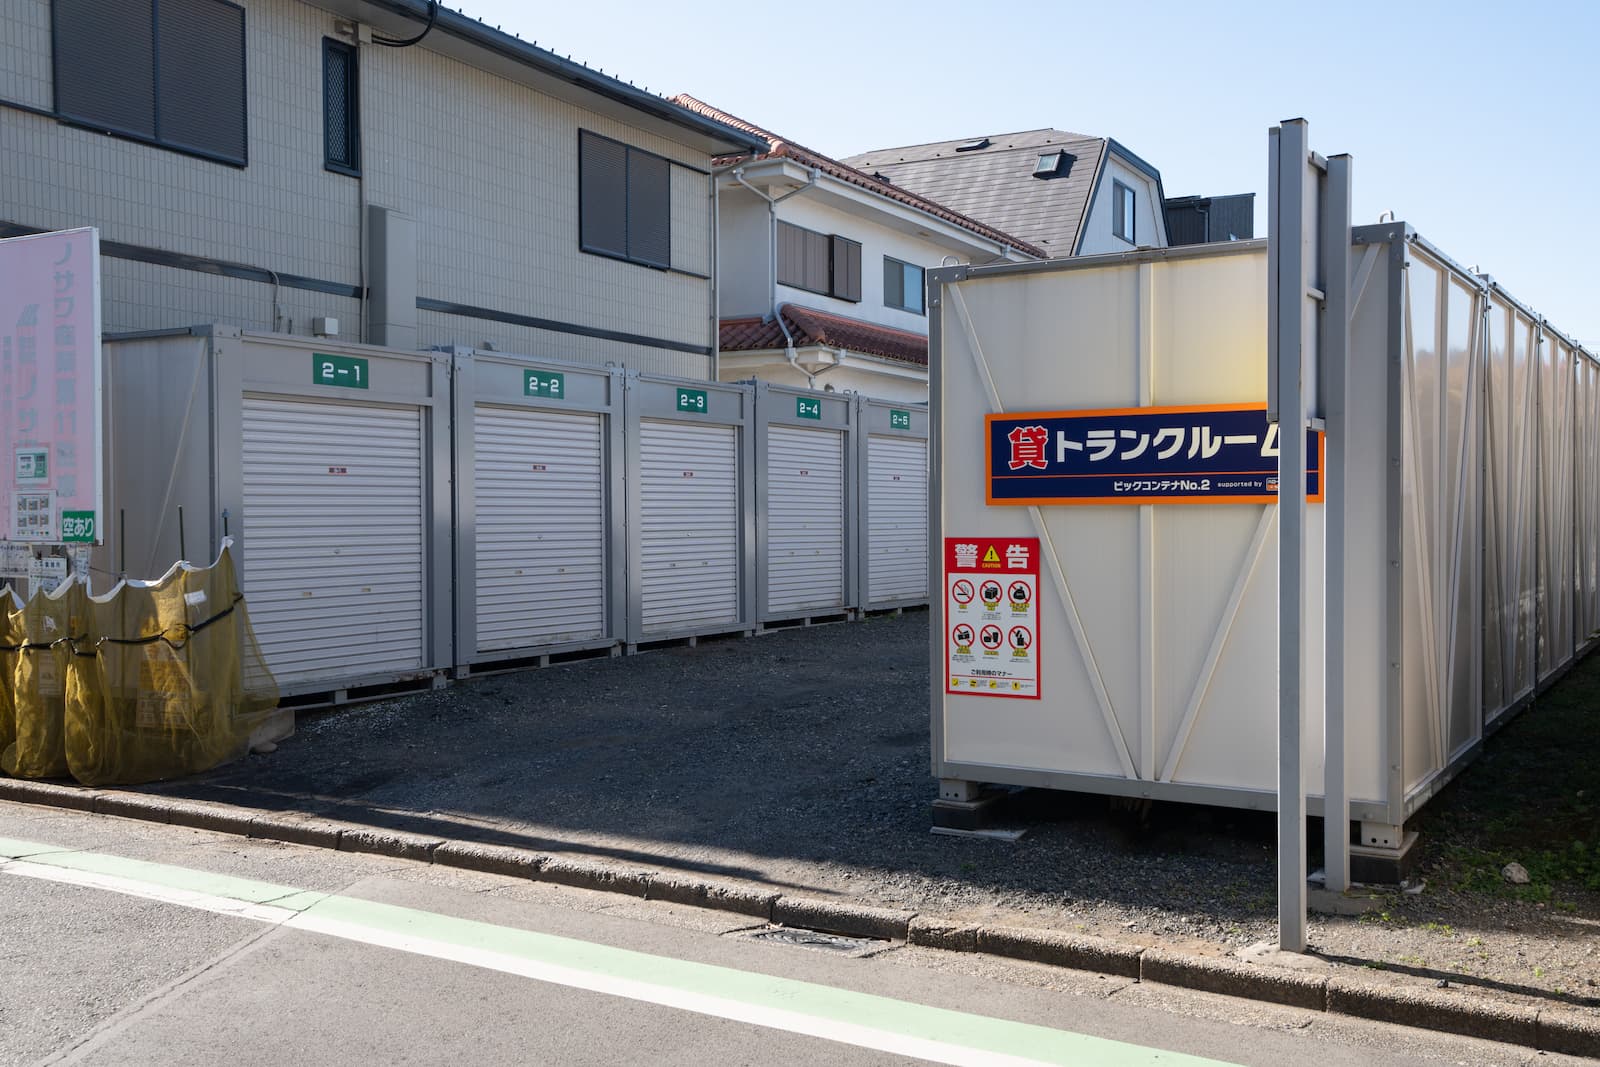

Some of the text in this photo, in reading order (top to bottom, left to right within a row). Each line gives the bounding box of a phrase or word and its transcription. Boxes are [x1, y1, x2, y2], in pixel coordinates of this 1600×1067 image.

[322, 362, 361, 381] 2-1
[529, 376, 559, 393] 2-2
[680, 394, 704, 407] 2-3
[800, 402, 818, 415] 2-4
[63, 517, 94, 537] 空あり
